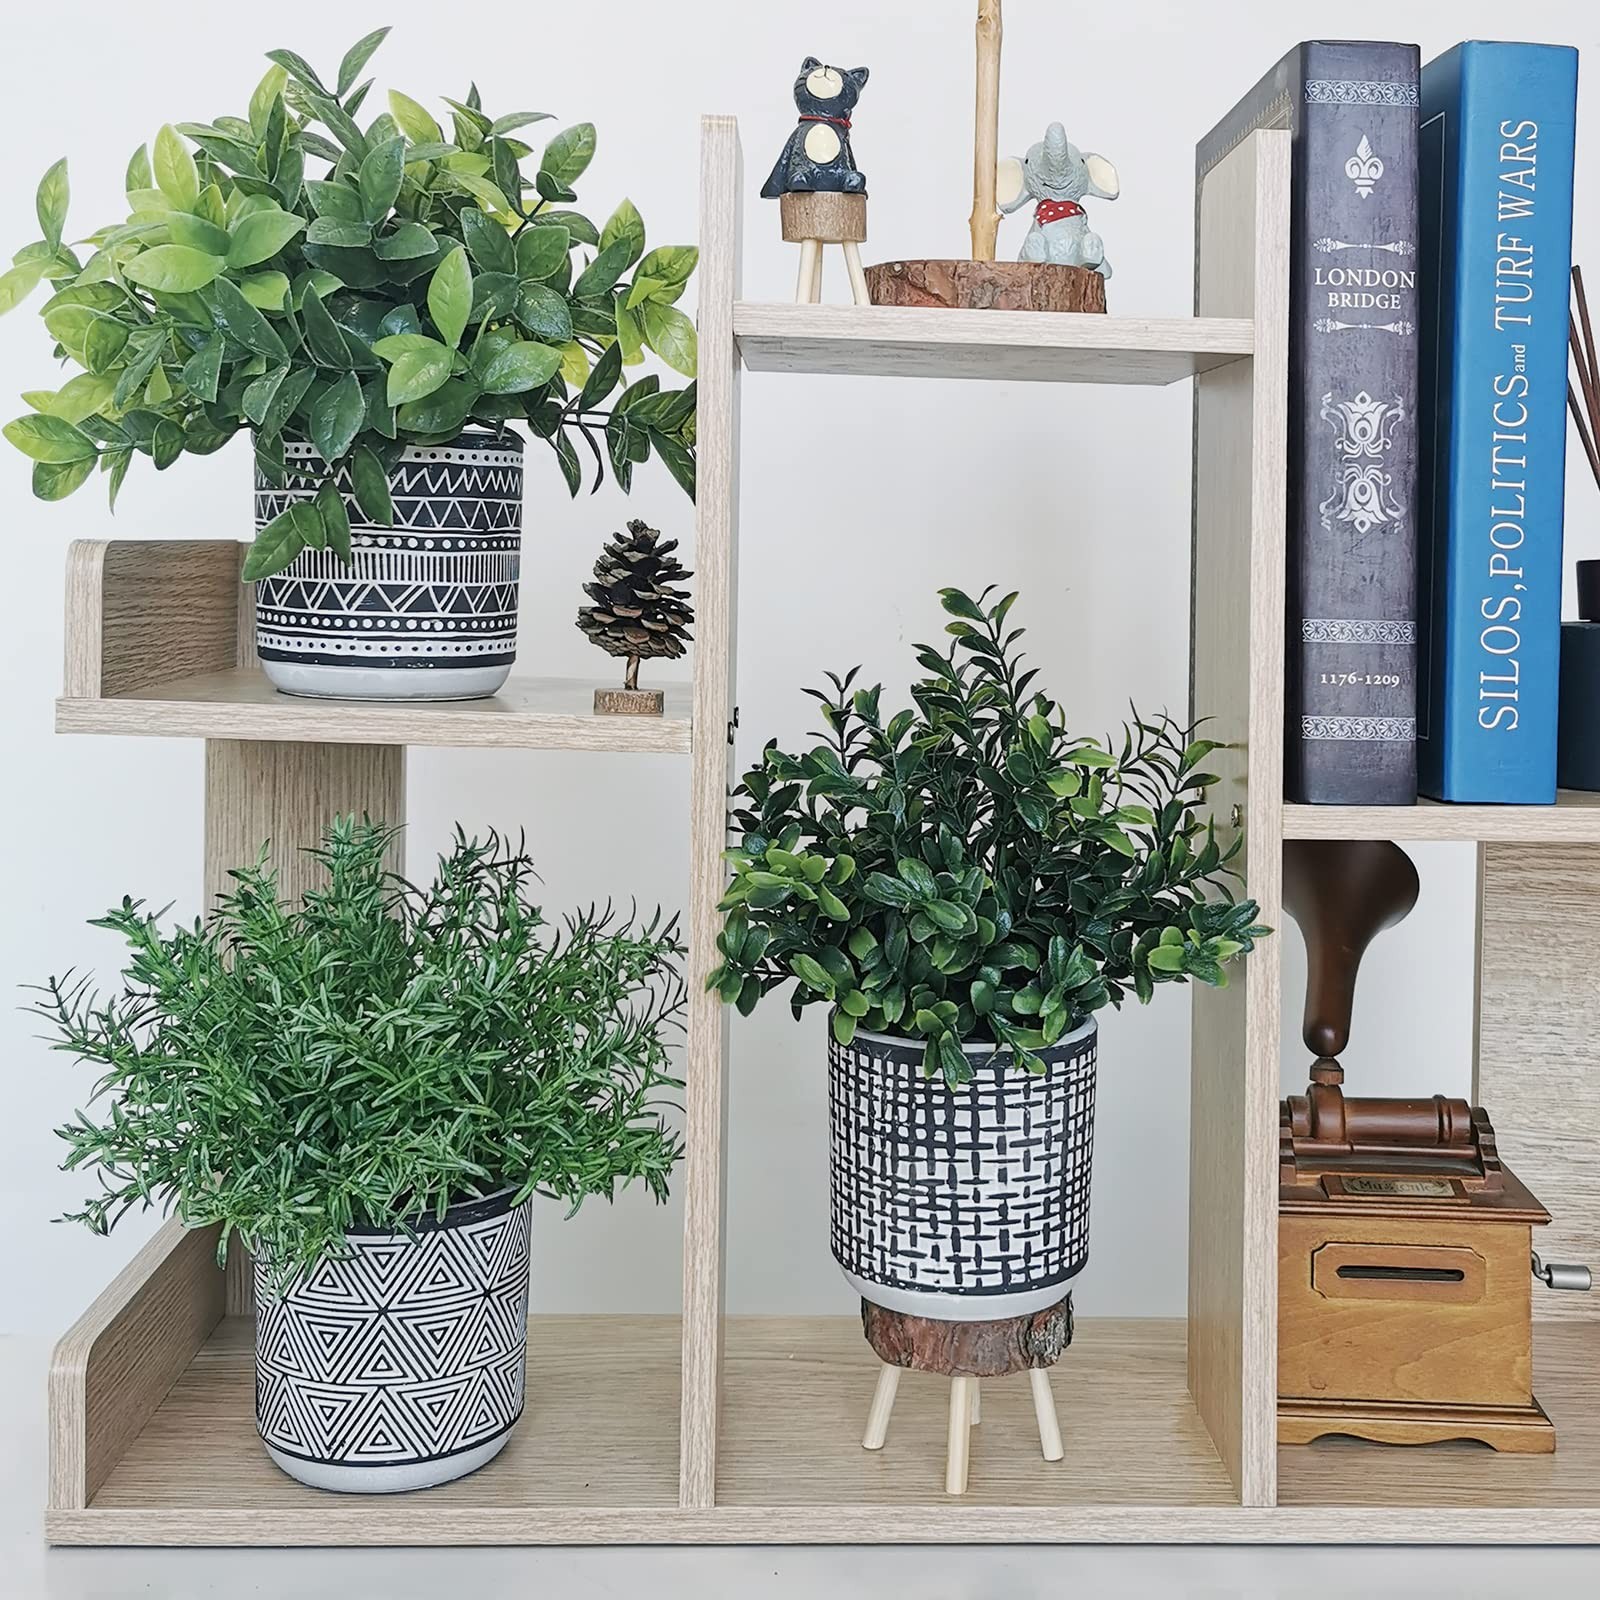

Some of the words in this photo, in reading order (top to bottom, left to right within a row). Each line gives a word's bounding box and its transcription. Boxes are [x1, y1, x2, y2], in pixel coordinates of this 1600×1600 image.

[1498, 119, 1538, 222] WARS
[1314, 267, 1416, 289] LONDON
[1495, 232, 1534, 331] TURF
[1327, 293, 1401, 310] BRIDGE
[1511, 344, 1526, 373] and
[1320, 671, 1400, 688] 1176-1209
